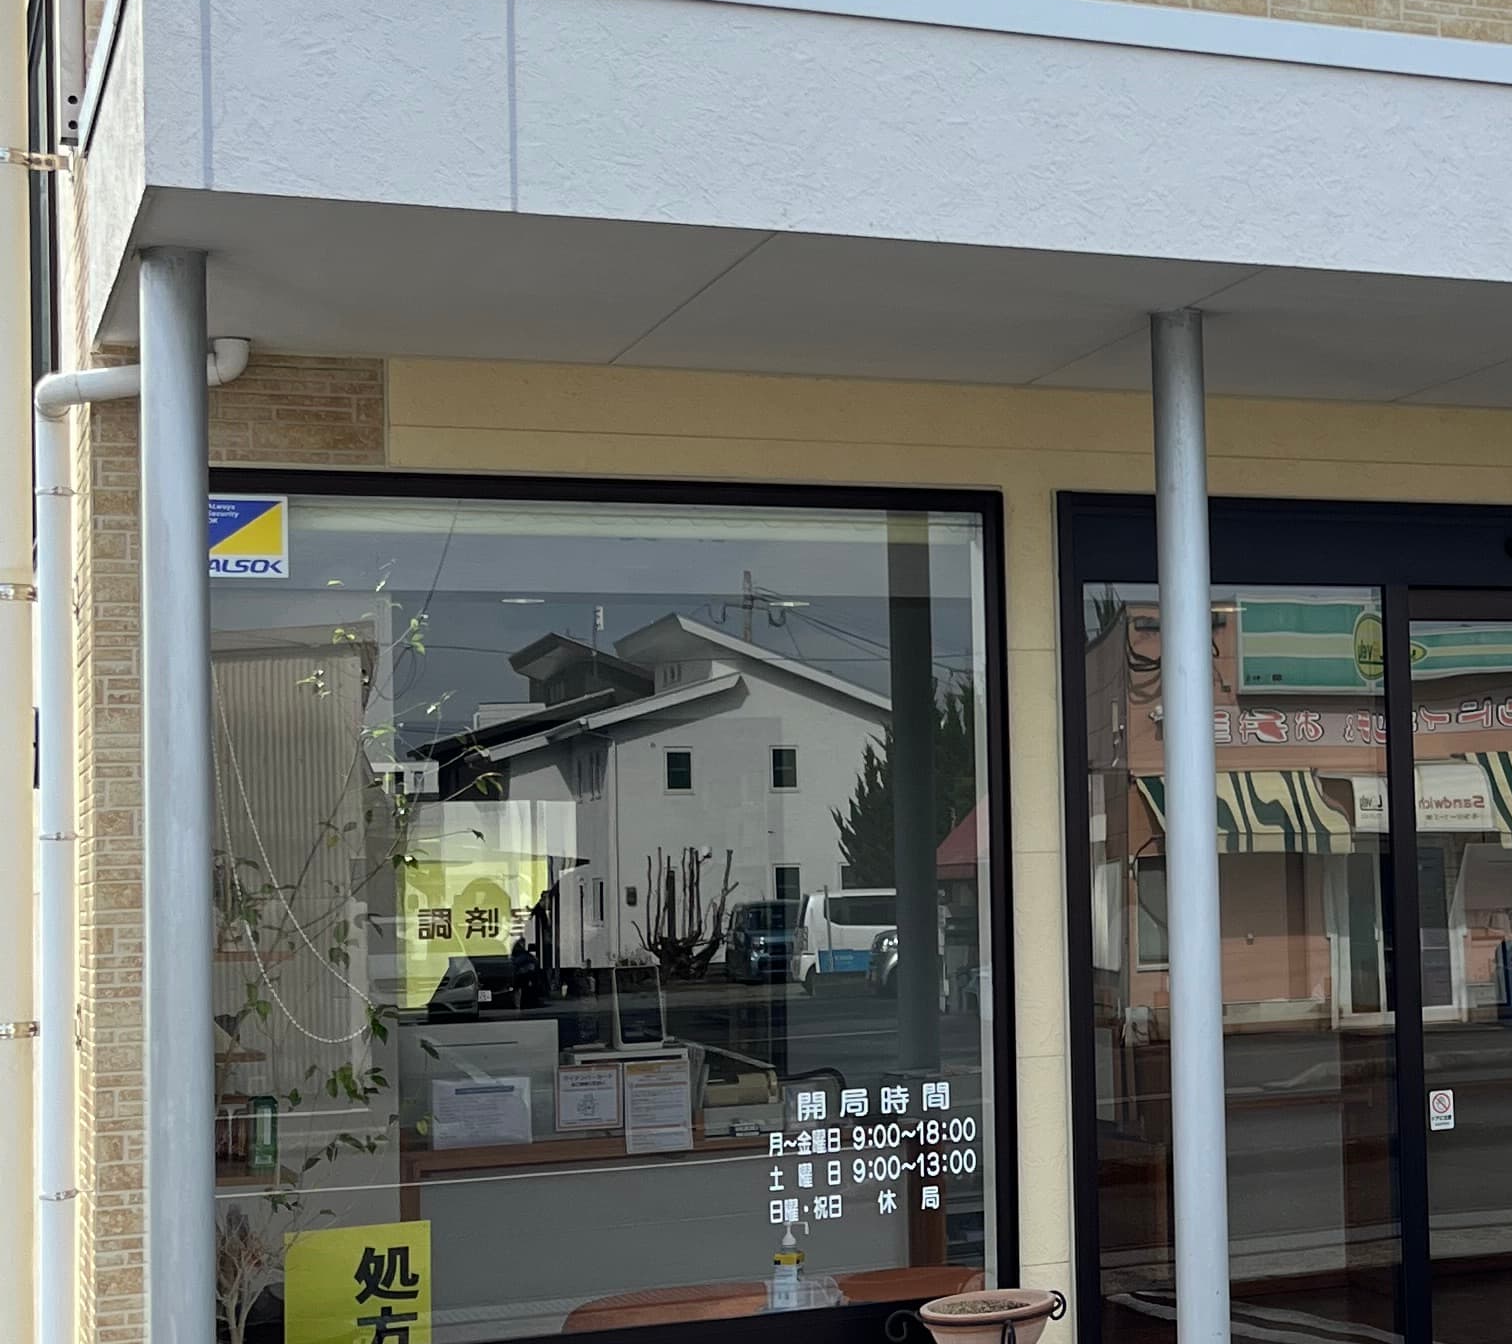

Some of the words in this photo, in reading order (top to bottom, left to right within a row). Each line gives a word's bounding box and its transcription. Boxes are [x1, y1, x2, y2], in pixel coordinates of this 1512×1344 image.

[209, 559, 283, 574] ALSOK
[797, 1082, 950, 1122] 開局時間
